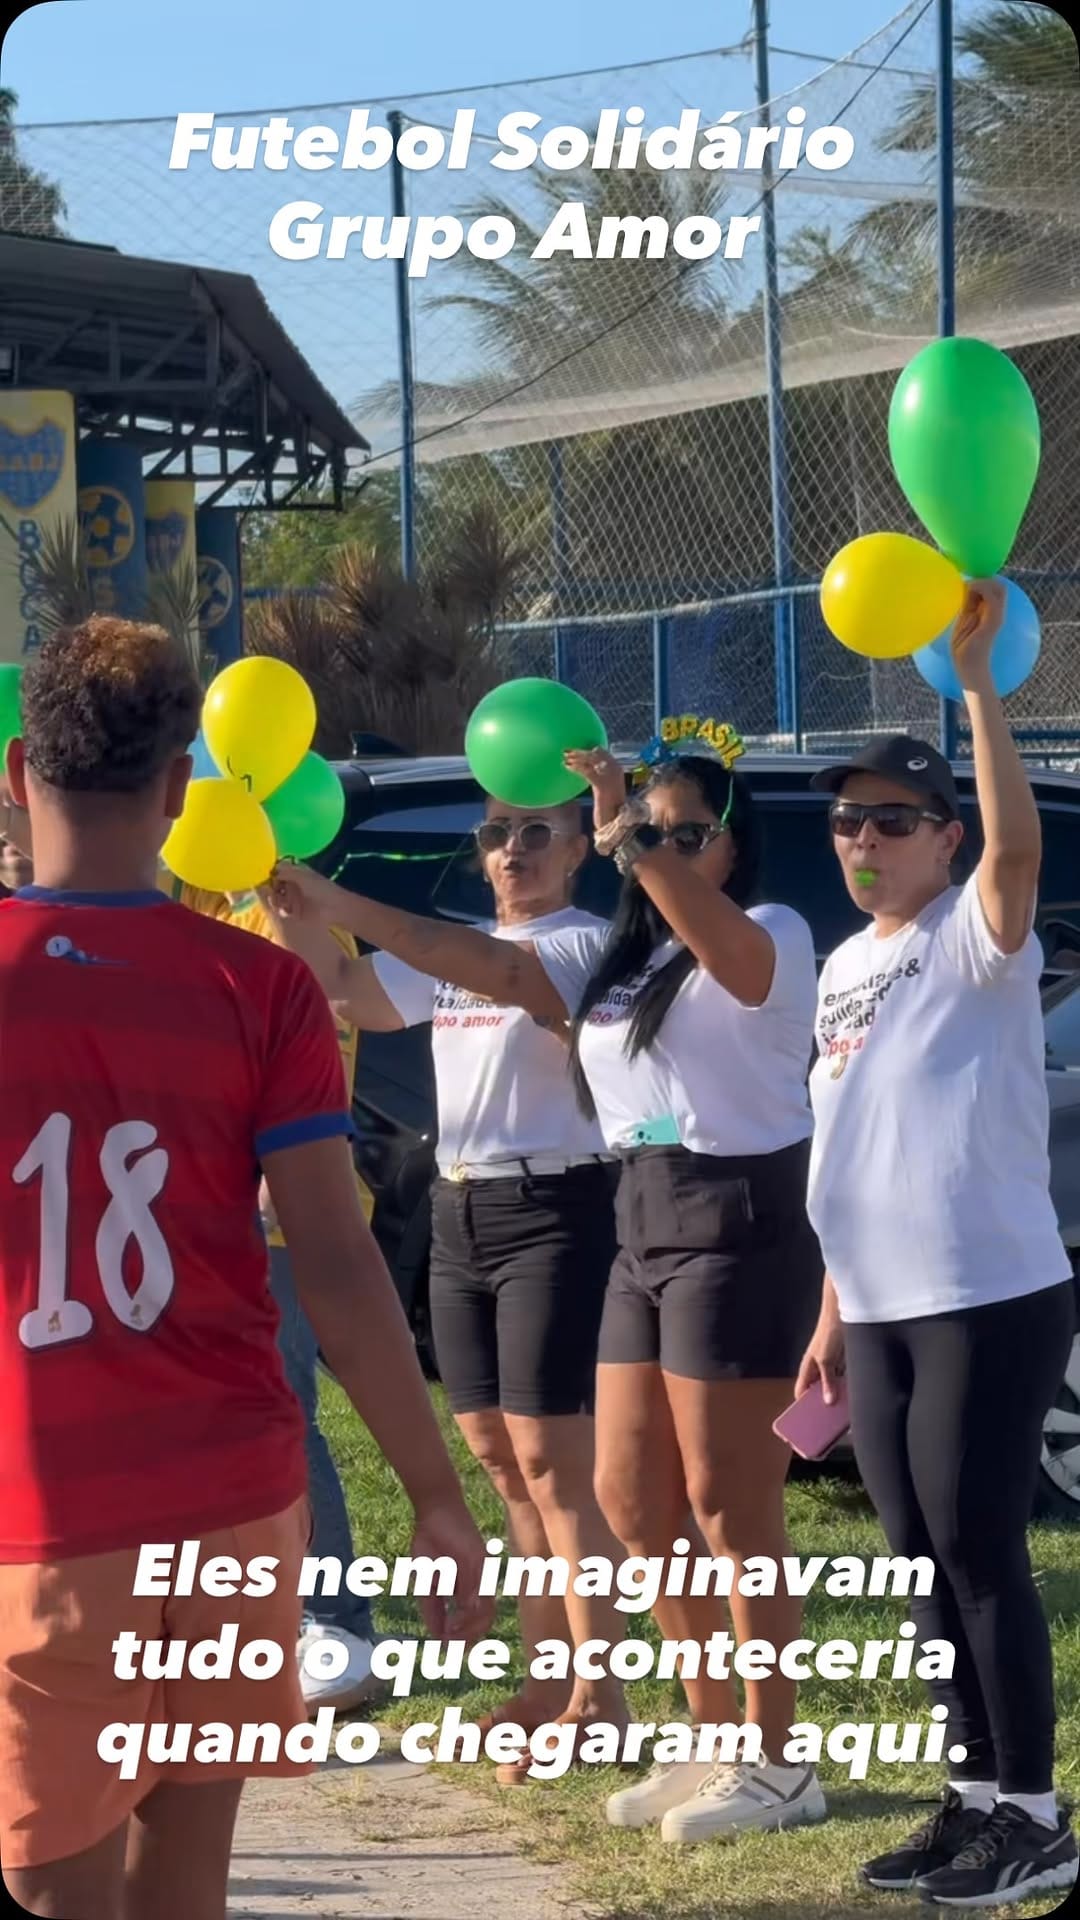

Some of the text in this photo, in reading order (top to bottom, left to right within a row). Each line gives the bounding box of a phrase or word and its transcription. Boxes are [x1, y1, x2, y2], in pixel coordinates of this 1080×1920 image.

[660, 713, 746, 770] BRASIL
[462, 1014, 504, 1028] amor
[12, 1111, 175, 1349] 18
